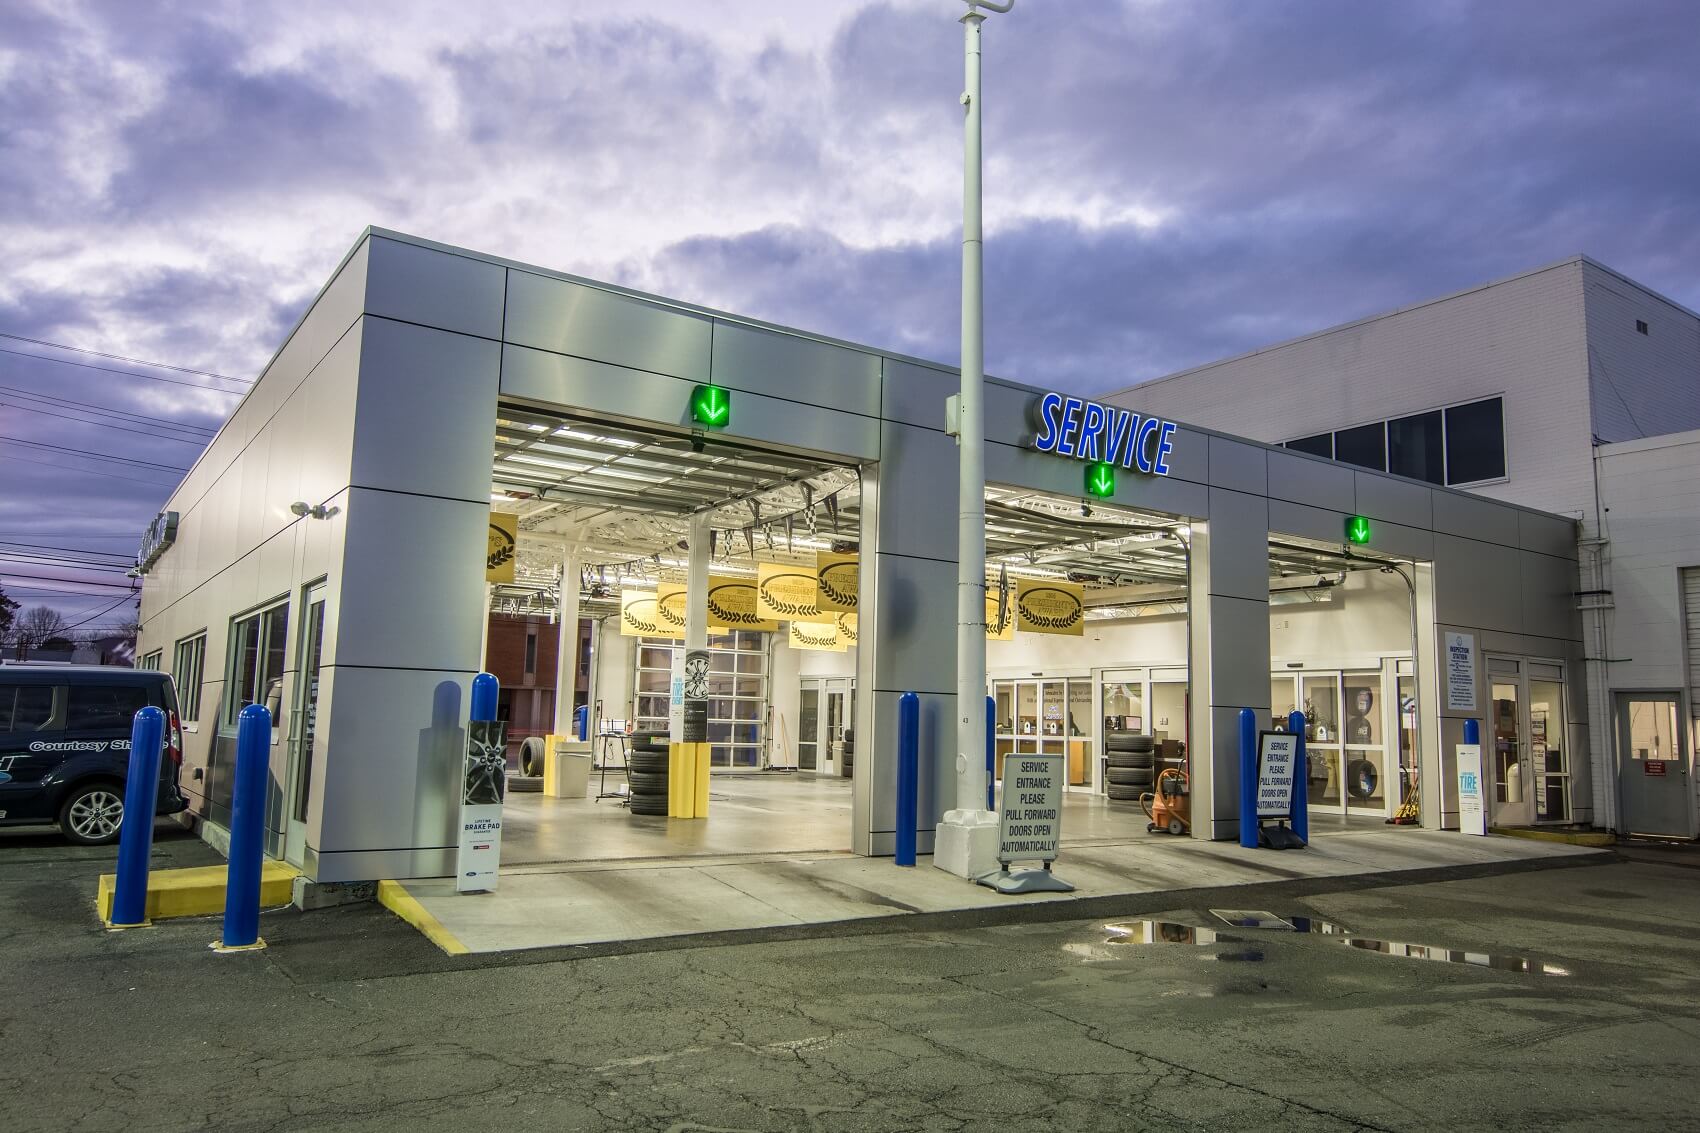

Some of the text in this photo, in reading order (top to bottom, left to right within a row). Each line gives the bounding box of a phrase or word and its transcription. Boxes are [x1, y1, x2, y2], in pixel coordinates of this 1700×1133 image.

[1036, 392, 1177, 476] SERVICE
[29, 741, 109, 752] Courtesy
[1271, 742, 1289, 751] SERVICE
[1267, 753, 1289, 762] ENTRANCE
[1021, 762, 1049, 773] SERVICE
[1269, 766, 1285, 774] PLEASE
[1016, 778, 1051, 788] ENTRANCE
[1260, 777, 1291, 786] PULL FORWARD
[1460, 776, 1477, 789] TIRE
[1020, 794, 1045, 804] PLEASE
[1262, 790, 1288, 798] DOORS OPEN
[1006, 809, 1056, 820] PULL FORWARD
[465, 823, 486, 831] BRAKE
[1009, 825, 1051, 836] DOORS OPEN
[1001, 841, 1056, 853] AUTOMATICALLY
